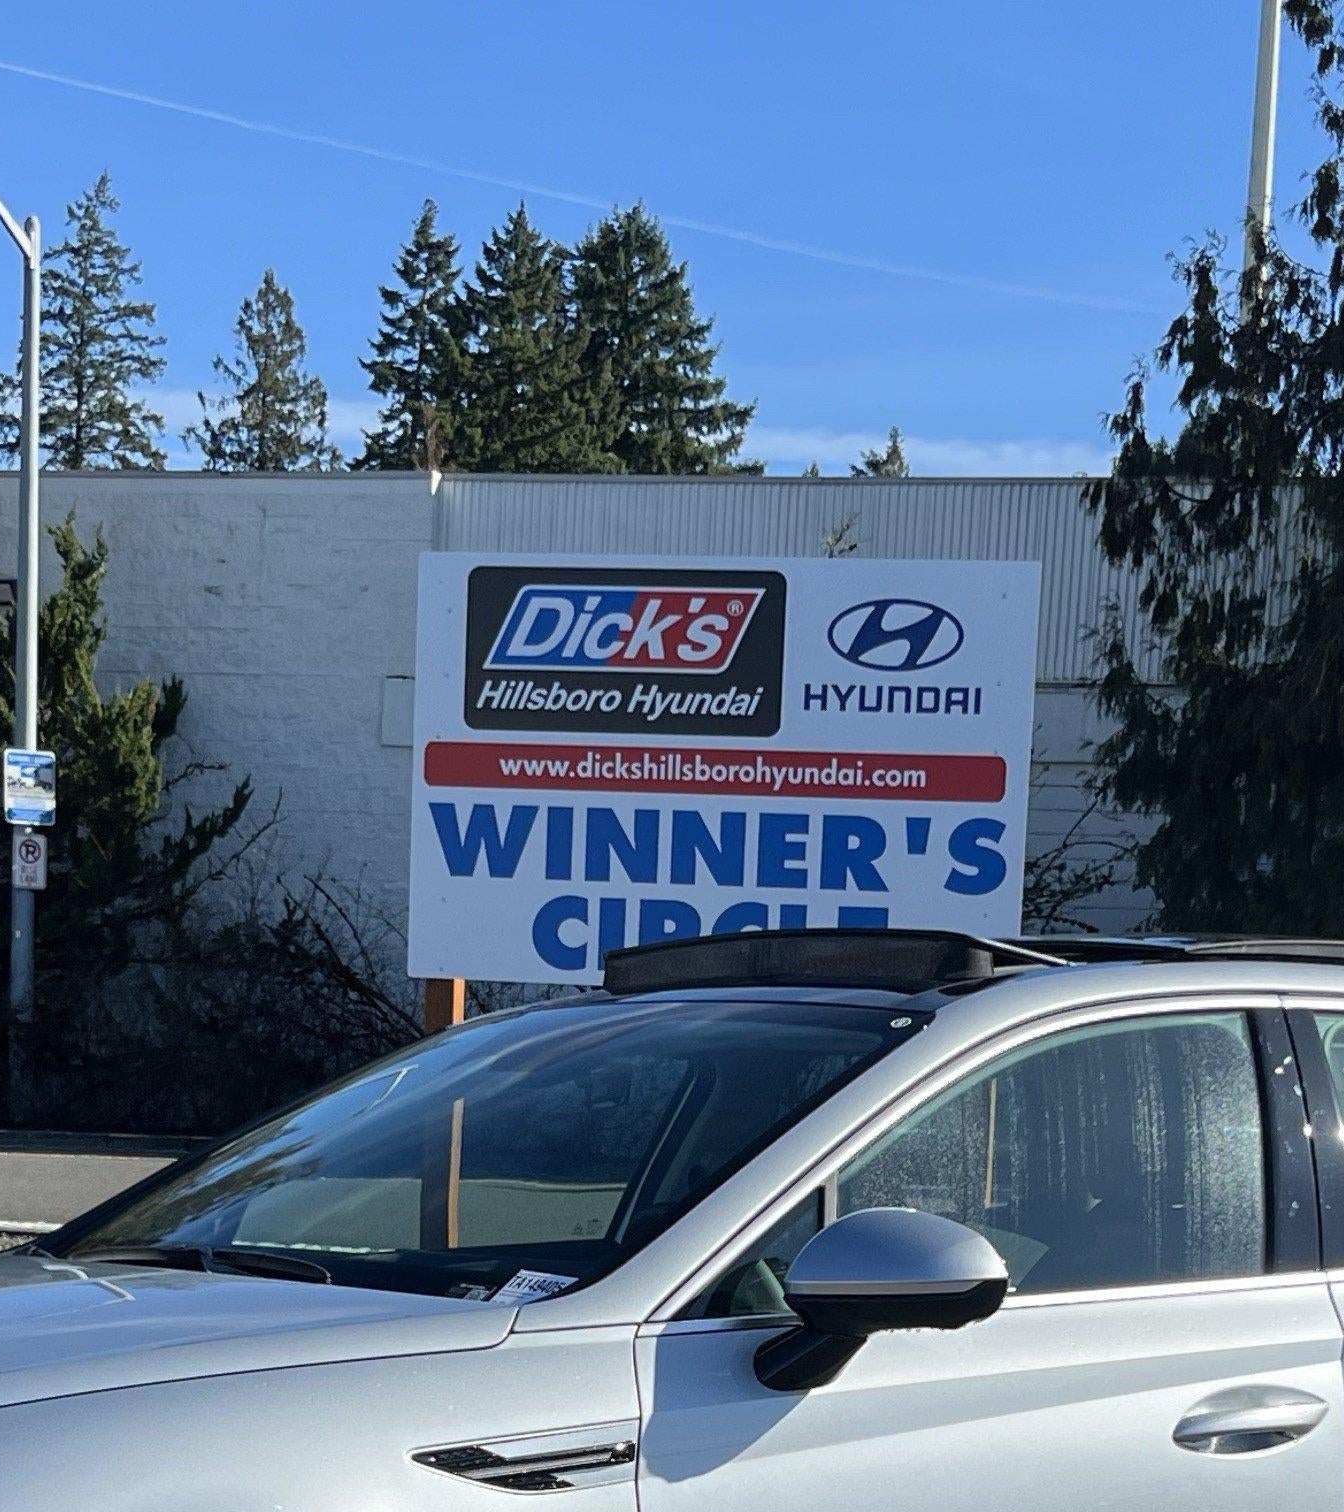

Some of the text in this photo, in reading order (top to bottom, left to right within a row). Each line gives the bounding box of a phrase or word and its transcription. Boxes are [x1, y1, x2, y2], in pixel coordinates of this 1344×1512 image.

[506, 596, 729, 662] Dick's
[476, 680, 764, 721] Hillsboro Hyundai
[804, 684, 981, 715] HYUNDAI
[499, 752, 926, 791] www.dickshillsborohyundai.com
[428, 802, 1007, 896] WINNER'S
